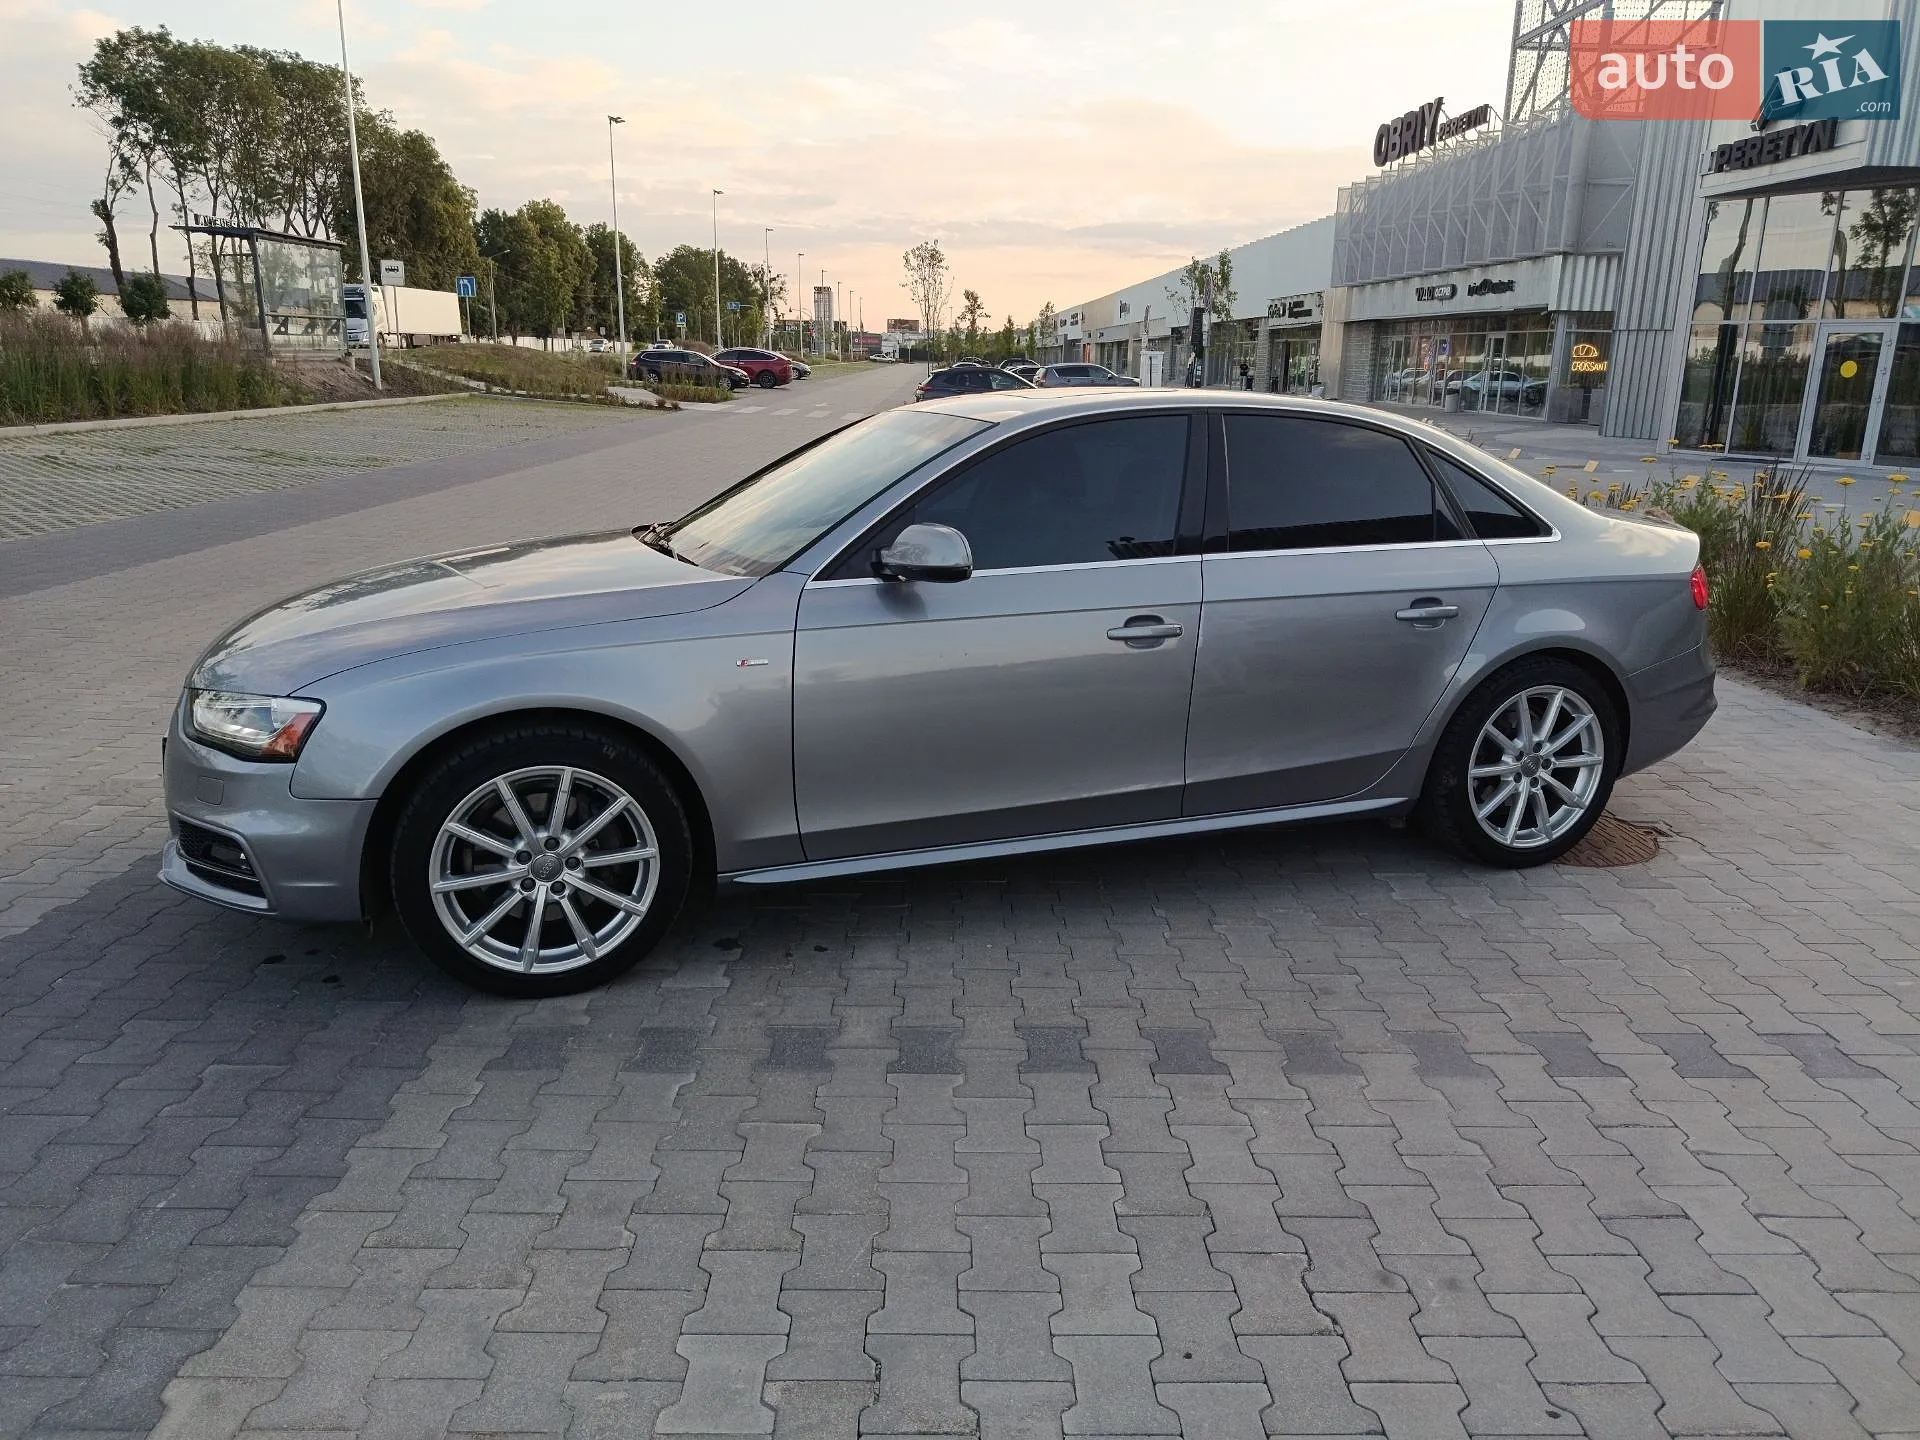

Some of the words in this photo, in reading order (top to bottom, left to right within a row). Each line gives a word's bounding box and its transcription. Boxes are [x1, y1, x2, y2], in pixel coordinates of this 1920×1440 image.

[1373, 96, 1444, 167] OBRIY
[1437, 103, 1490, 142] PERETYN
[1713, 116, 1839, 173] PERETYN
